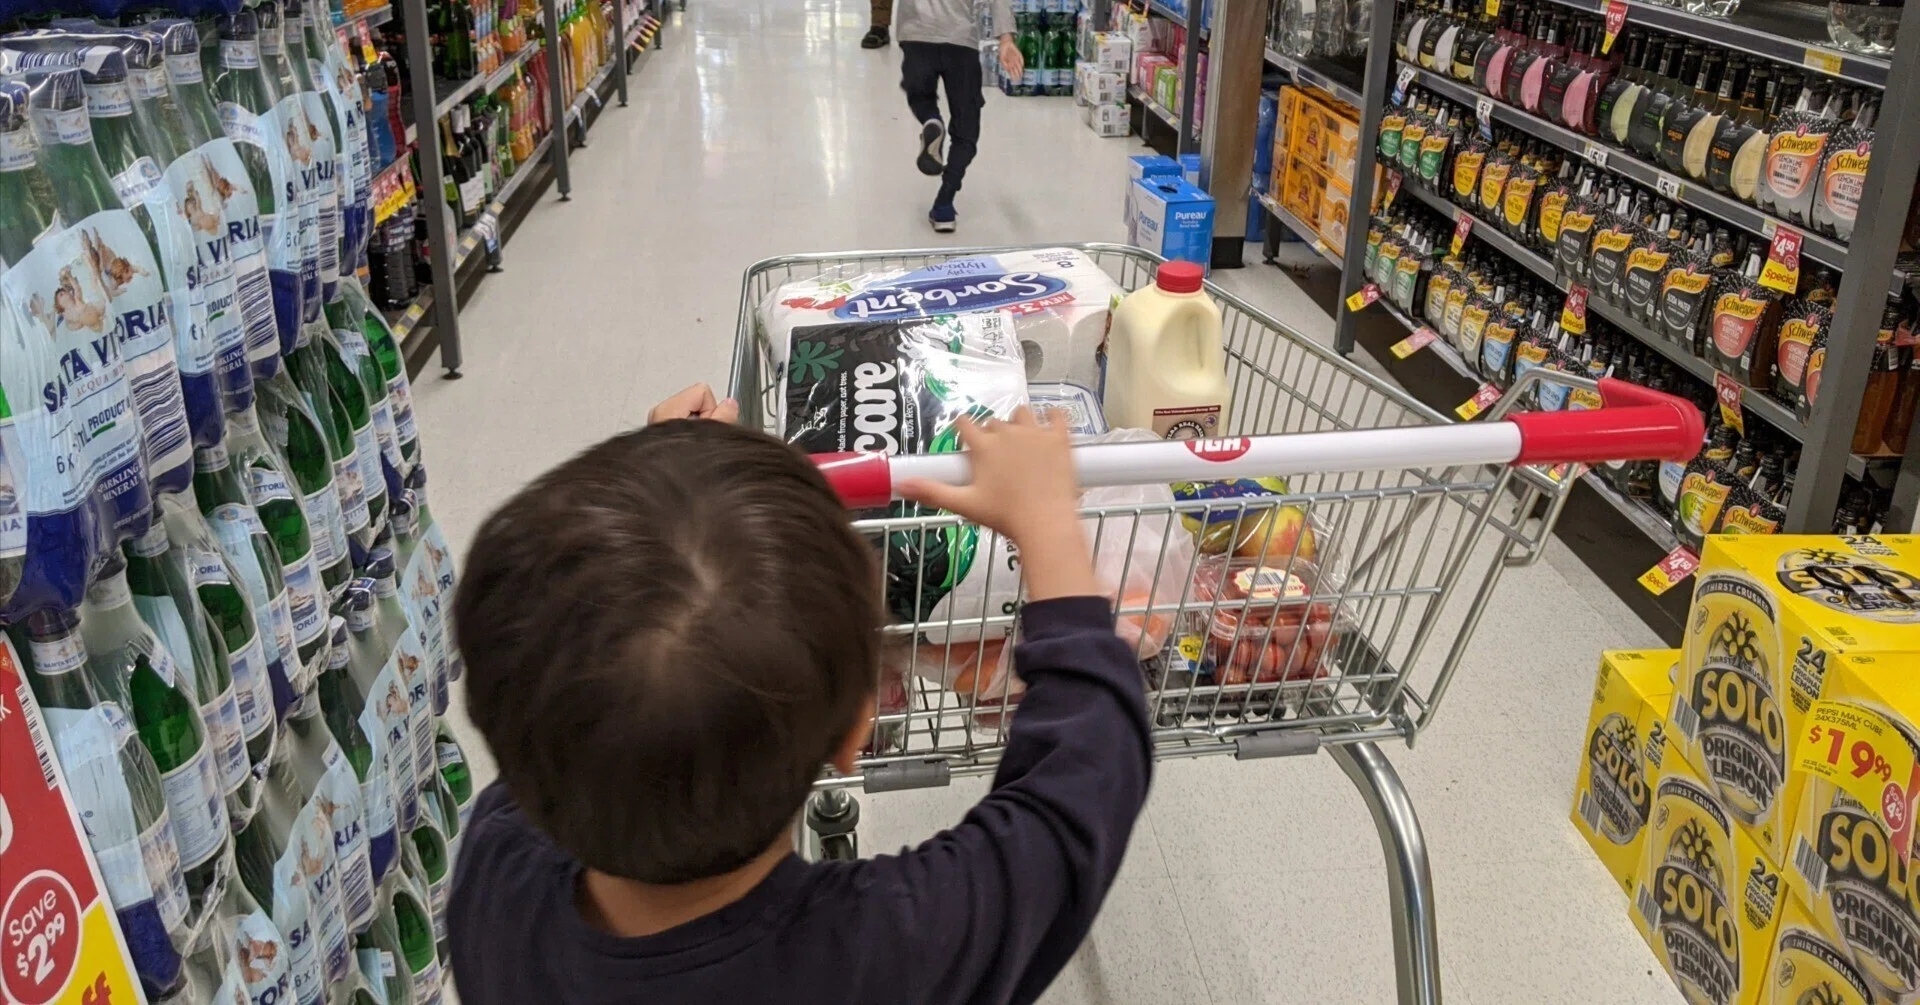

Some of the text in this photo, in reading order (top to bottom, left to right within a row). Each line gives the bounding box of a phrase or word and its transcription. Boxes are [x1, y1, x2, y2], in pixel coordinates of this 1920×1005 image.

[1712, 147, 1731, 159] GINGER
[1775, 136, 1818, 151] Schweppes
[1833, 154, 1869, 171] Schwep
[1841, 184, 1860, 194] BITTERS
[1599, 232, 1626, 248] Schweppes
[1632, 251, 1662, 267] Schweppes
[1629, 271, 1651, 290] SODA WATER
[1670, 272, 1702, 288] Schweppes
[1764, 268, 1796, 286] Special
[850, 271, 1048, 318] Sorbent
[1667, 293, 1691, 312] SODA WATER
[1722, 298, 1758, 316] Schweppes
[1785, 322, 1815, 341] Schwep
[838, 417, 847, 433] from
[56, 455, 65, 474] 6
[1688, 477, 1722, 498] Schweppes
[1729, 509, 1769, 533] Schweppes
[1706, 583, 1770, 612] THIRST CRUSHER
[293, 614, 318, 632] TORIA
[1796, 636, 1827, 676] 24
[1790, 671, 1820, 700] LEMON
[1792, 664, 1820, 693] ORIGINAL
[1701, 670, 1783, 754] SOLO
[1814, 714, 1858, 731] 24X375ML
[1816, 707, 1884, 737] PEPSI MAX CUBE
[1595, 733, 1645, 806] SOLO
[1703, 737, 1774, 798] ORIGINAL
[1712, 757, 1767, 811] LEMON
[1667, 785, 1725, 827] THIRST CRUSHER
[1840, 798, 1864, 810] THIRS
[1750, 856, 1779, 897] 24
[1744, 887, 1772, 920] LEMON
[9, 889, 57, 946] Save
[1662, 868, 1738, 964] SOLO
[1844, 917, 1915, 991] LEMON
[1665, 931, 1730, 1004] ORIGINAL
[1792, 938, 1868, 1000] THIRST CRUSHER
